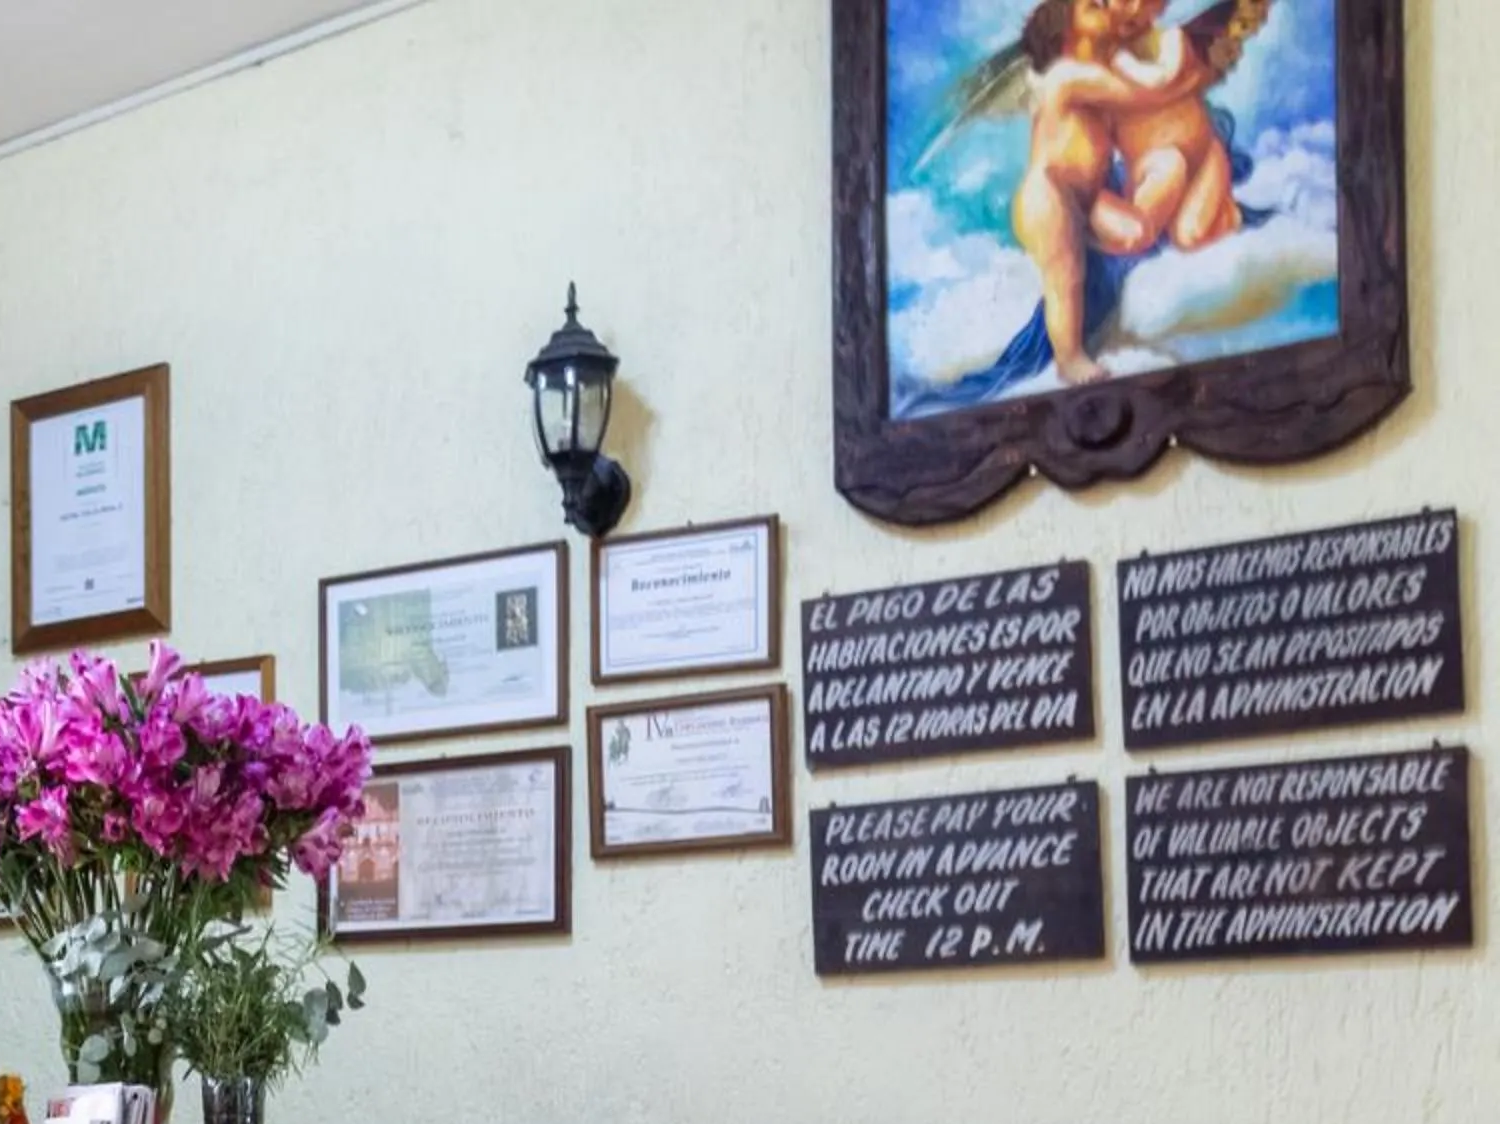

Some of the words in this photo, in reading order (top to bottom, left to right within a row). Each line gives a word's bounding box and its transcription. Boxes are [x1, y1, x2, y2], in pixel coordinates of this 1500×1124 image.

[75, 420, 106, 456] M
[1123, 565, 1159, 600] NO
[1158, 557, 1205, 594] NOS
[1206, 543, 1304, 587] HACEMOS
[1302, 518, 1454, 571] RESPONSABLES
[810, 603, 838, 632] EL
[847, 590, 925, 625] PAGO
[932, 581, 981, 616] DE
[985, 568, 1060, 610] LAS
[1135, 605, 1178, 643] POR
[1182, 590, 1280, 634] OBJETOS
[1281, 590, 1299, 621] O
[1302, 565, 1427, 620] VALORES
[807, 619, 990, 673] HABITACIONES
[990, 613, 1021, 650] ES
[1021, 606, 1081, 646] POR
[1128, 649, 1175, 688] QUE
[1174, 643, 1212, 681] NO
[1283, 610, 1445, 665] DEPOSITADOS
[808, 664, 964, 713] ADELANTADO
[966, 662, 987, 695] Y
[987, 651, 1074, 691] VENCE
[1131, 694, 1170, 731] EN
[1170, 686, 1206, 726] LA
[1211, 657, 1445, 720] ADMINISTRACION
[810, 722, 826, 752] A
[831, 716, 880, 749] LAS
[884, 712, 913, 744] 12
[913, 704, 989, 741] HORAS
[989, 698, 1030, 733] DEL
[1030, 692, 1078, 728] DIA
[1134, 781, 1173, 815] WE
[1177, 777, 1230, 811] ARE
[1230, 771, 1281, 806] NOT
[1279, 757, 1453, 802] RESPONSABLE
[825, 805, 930, 846] PLEASE
[930, 798, 988, 834] PAY
[992, 789, 1077, 829] YOUR
[1133, 828, 1164, 859] OF
[1167, 816, 1284, 858] VALUABLE
[1291, 803, 1428, 848] OBJECTS
[821, 852, 897, 887] ROOM
[896, 845, 933, 878] IN
[935, 833, 1078, 876] ADVANCE
[1139, 866, 1211, 903] THAT
[1211, 863, 1264, 899] ARE
[1264, 858, 1333, 896] NOT
[1337, 849, 1447, 890] KEPT
[862, 886, 949, 923] CHECK
[954, 880, 1019, 915] OUT
[1134, 911, 1173, 950] IN
[1173, 907, 1230, 950] THE
[1226, 892, 1459, 946] ADMINISTRATION
[845, 928, 905, 963] TIME
[925, 925, 963, 959] 12
